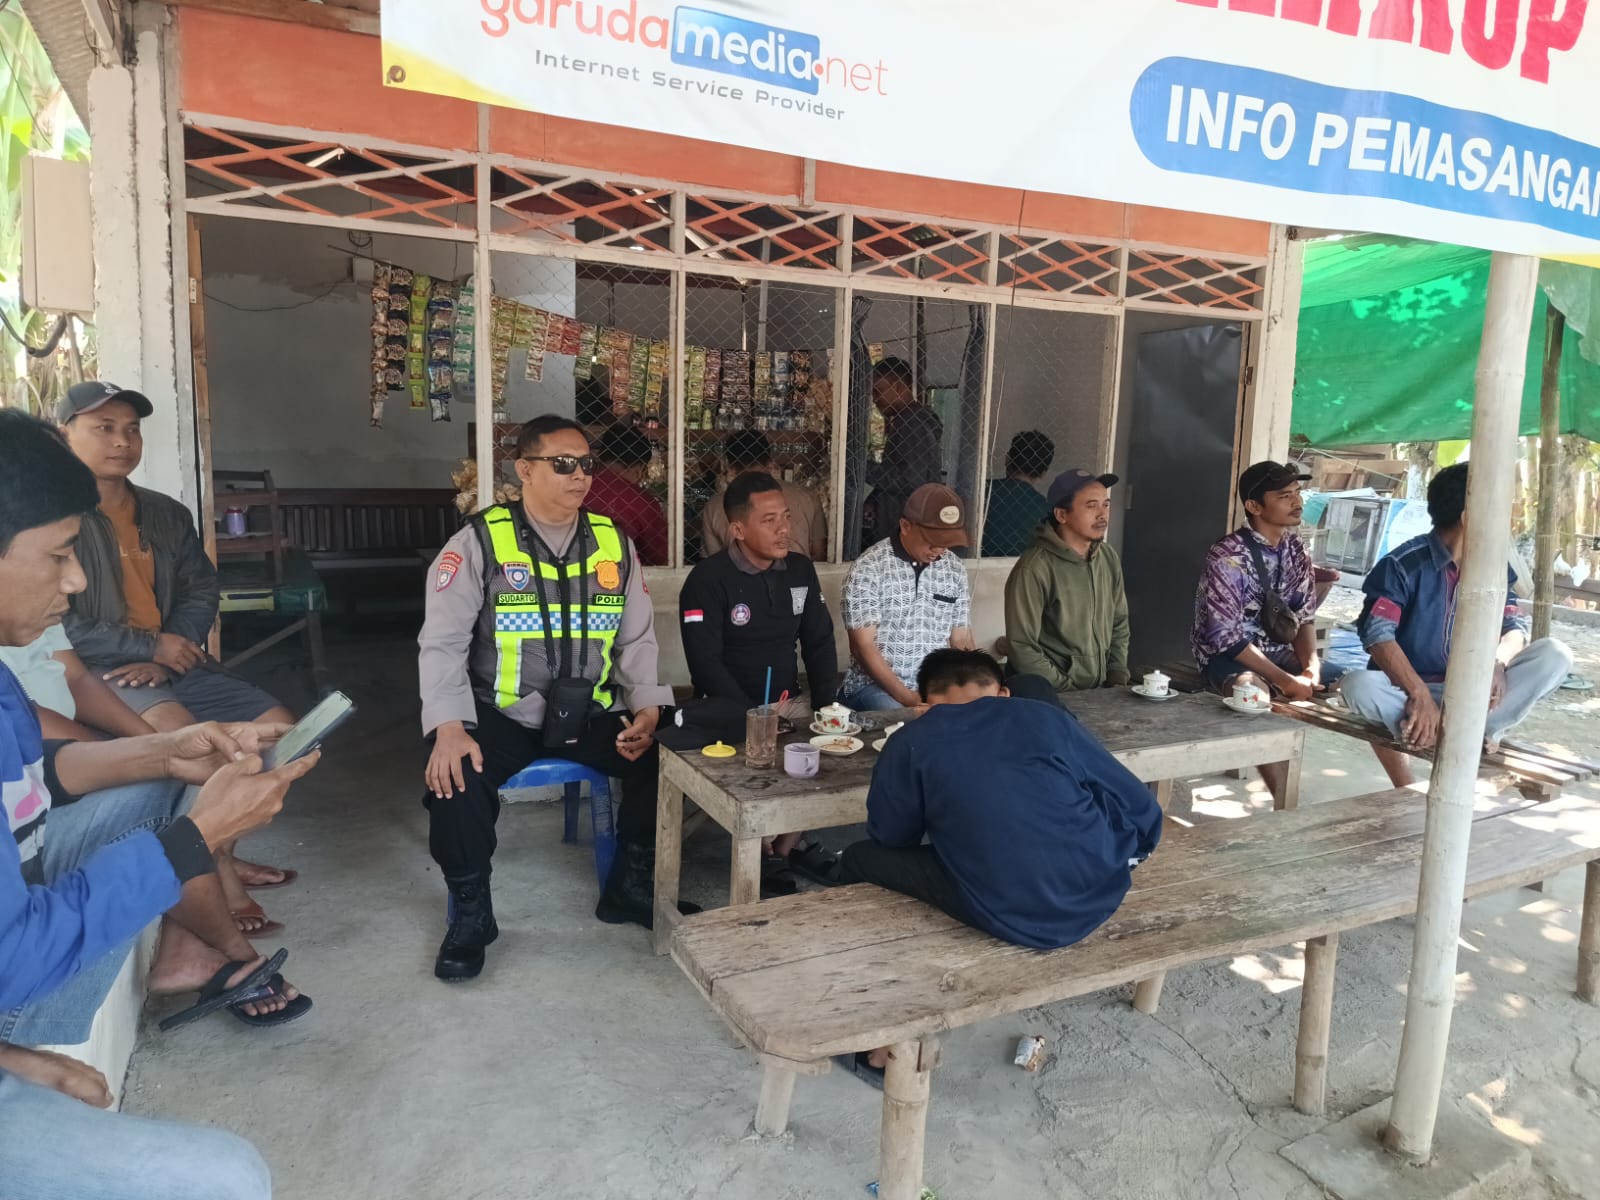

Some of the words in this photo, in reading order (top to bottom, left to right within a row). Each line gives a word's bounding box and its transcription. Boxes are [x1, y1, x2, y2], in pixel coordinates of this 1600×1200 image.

[535, 49, 641, 82] Internet
[652, 71, 744, 100] Service
[755, 89, 846, 120] Provider
[1166, 84, 1296, 161] INFO
[499, 594, 535, 603] SUDARTO
